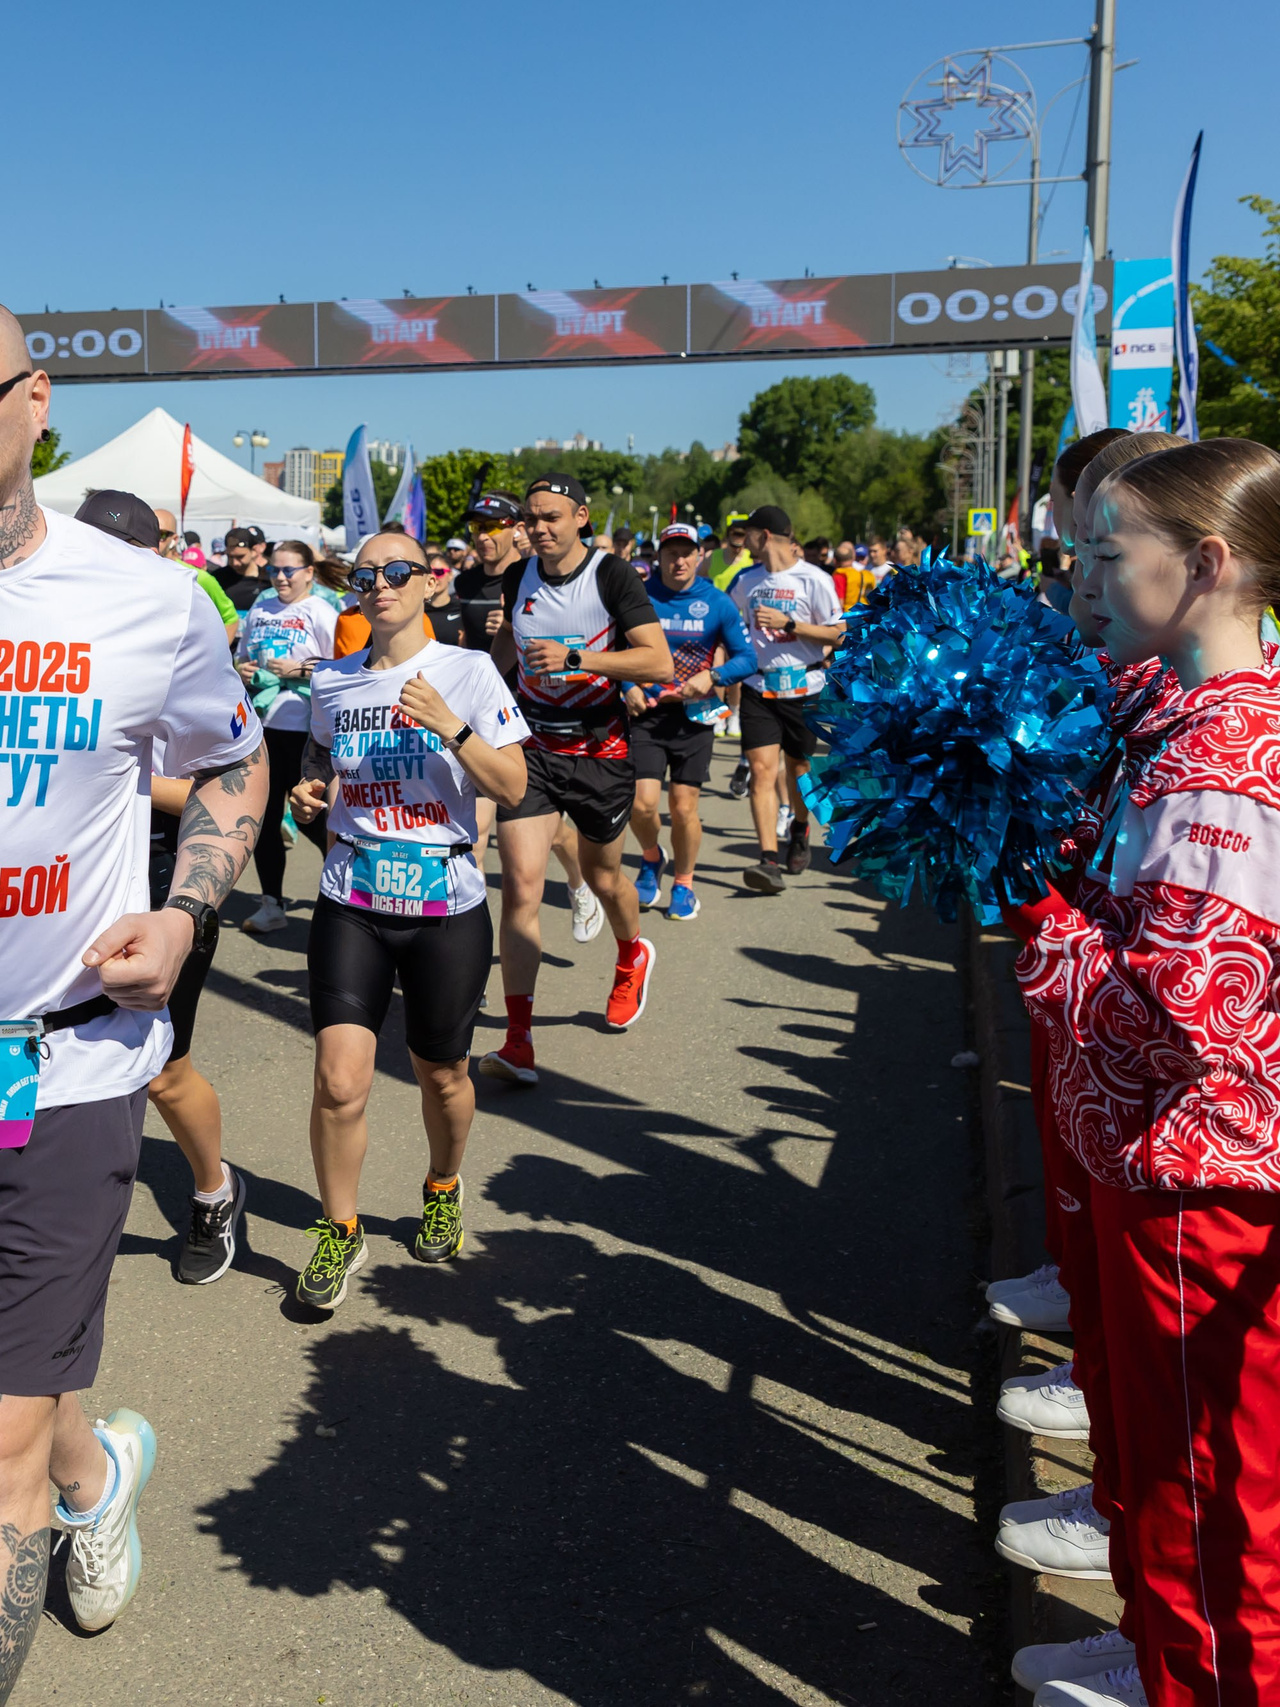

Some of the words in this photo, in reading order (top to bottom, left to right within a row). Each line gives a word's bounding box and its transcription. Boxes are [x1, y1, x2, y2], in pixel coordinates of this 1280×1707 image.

[751, 301, 826, 328] СТАРТ
[897, 284, 1108, 325] 00:00
[371, 318, 438, 344] СТАРТ
[555, 310, 626, 337] СТАРТ
[25, 327, 143, 360] 0:00
[197, 325, 260, 350] СТАРТ
[1131, 343, 1155, 353] ПСБ
[351, 488, 368, 537] ПСБ
[334, 704, 424, 733] #ЗАБЕГ20
[331, 733, 354, 758] 5%
[357, 728, 446, 757] ПЛАНЕТЫ
[371, 755, 426, 781] БЕГУТ
[342, 781, 404, 808] ВМЕСТЕ
[374, 808, 388, 832] С
[390, 799, 451, 831] ТОБОЙ
[375, 859, 423, 897] 652
[372, 893, 394, 912] ПСБ
[394, 898, 403, 914] 5
[404, 898, 423, 916] КМ
